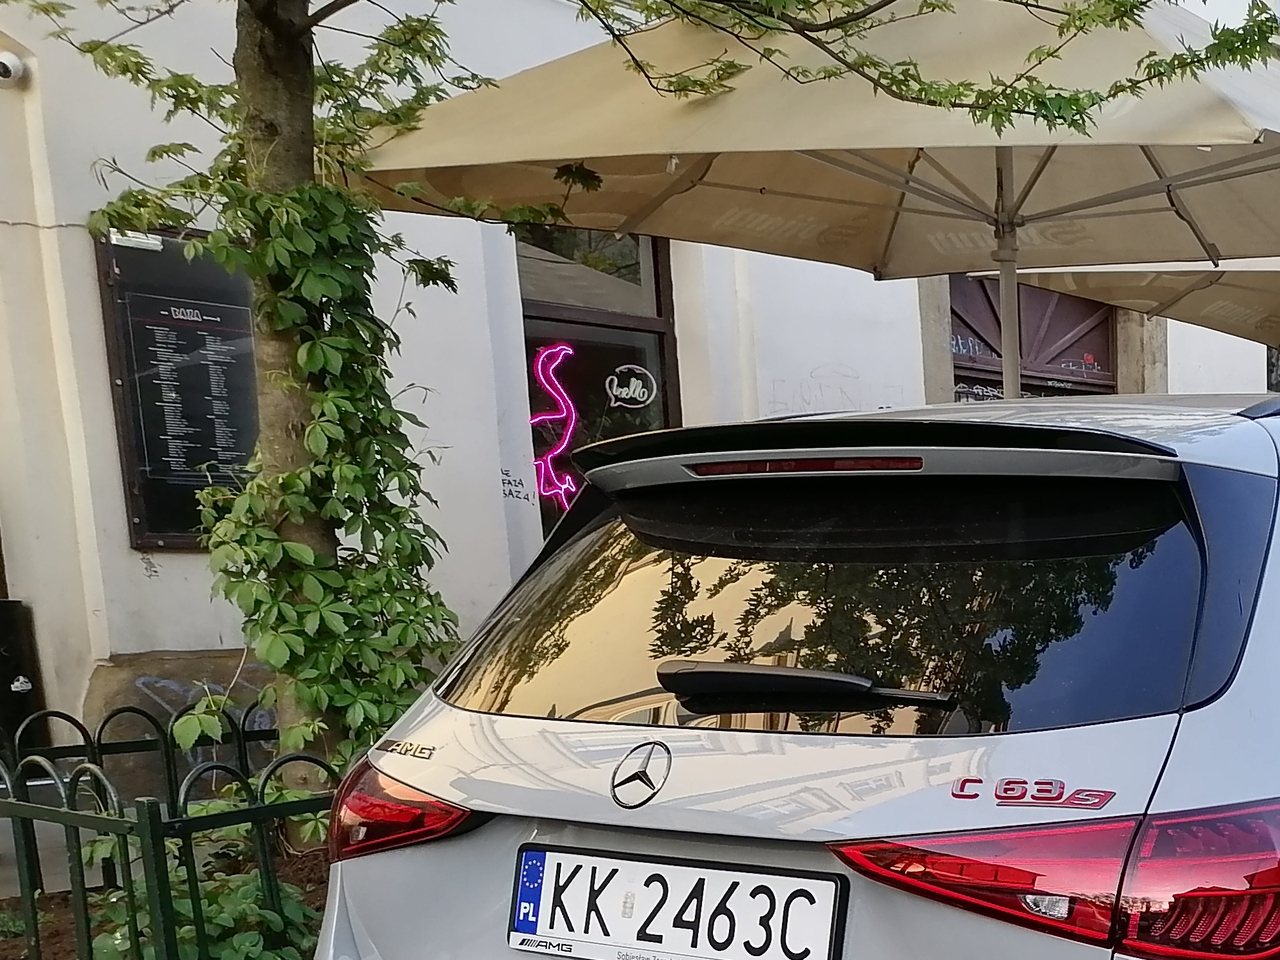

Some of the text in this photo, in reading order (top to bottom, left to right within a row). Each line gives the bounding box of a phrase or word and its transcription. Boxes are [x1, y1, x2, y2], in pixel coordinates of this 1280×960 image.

[387, 740, 435, 760] AMG
[951, 776, 983, 799] C
[519, 902, 536, 922] PL
[549, 862, 817, 960] KK 2463C
[533, 940, 573, 953] AMG
